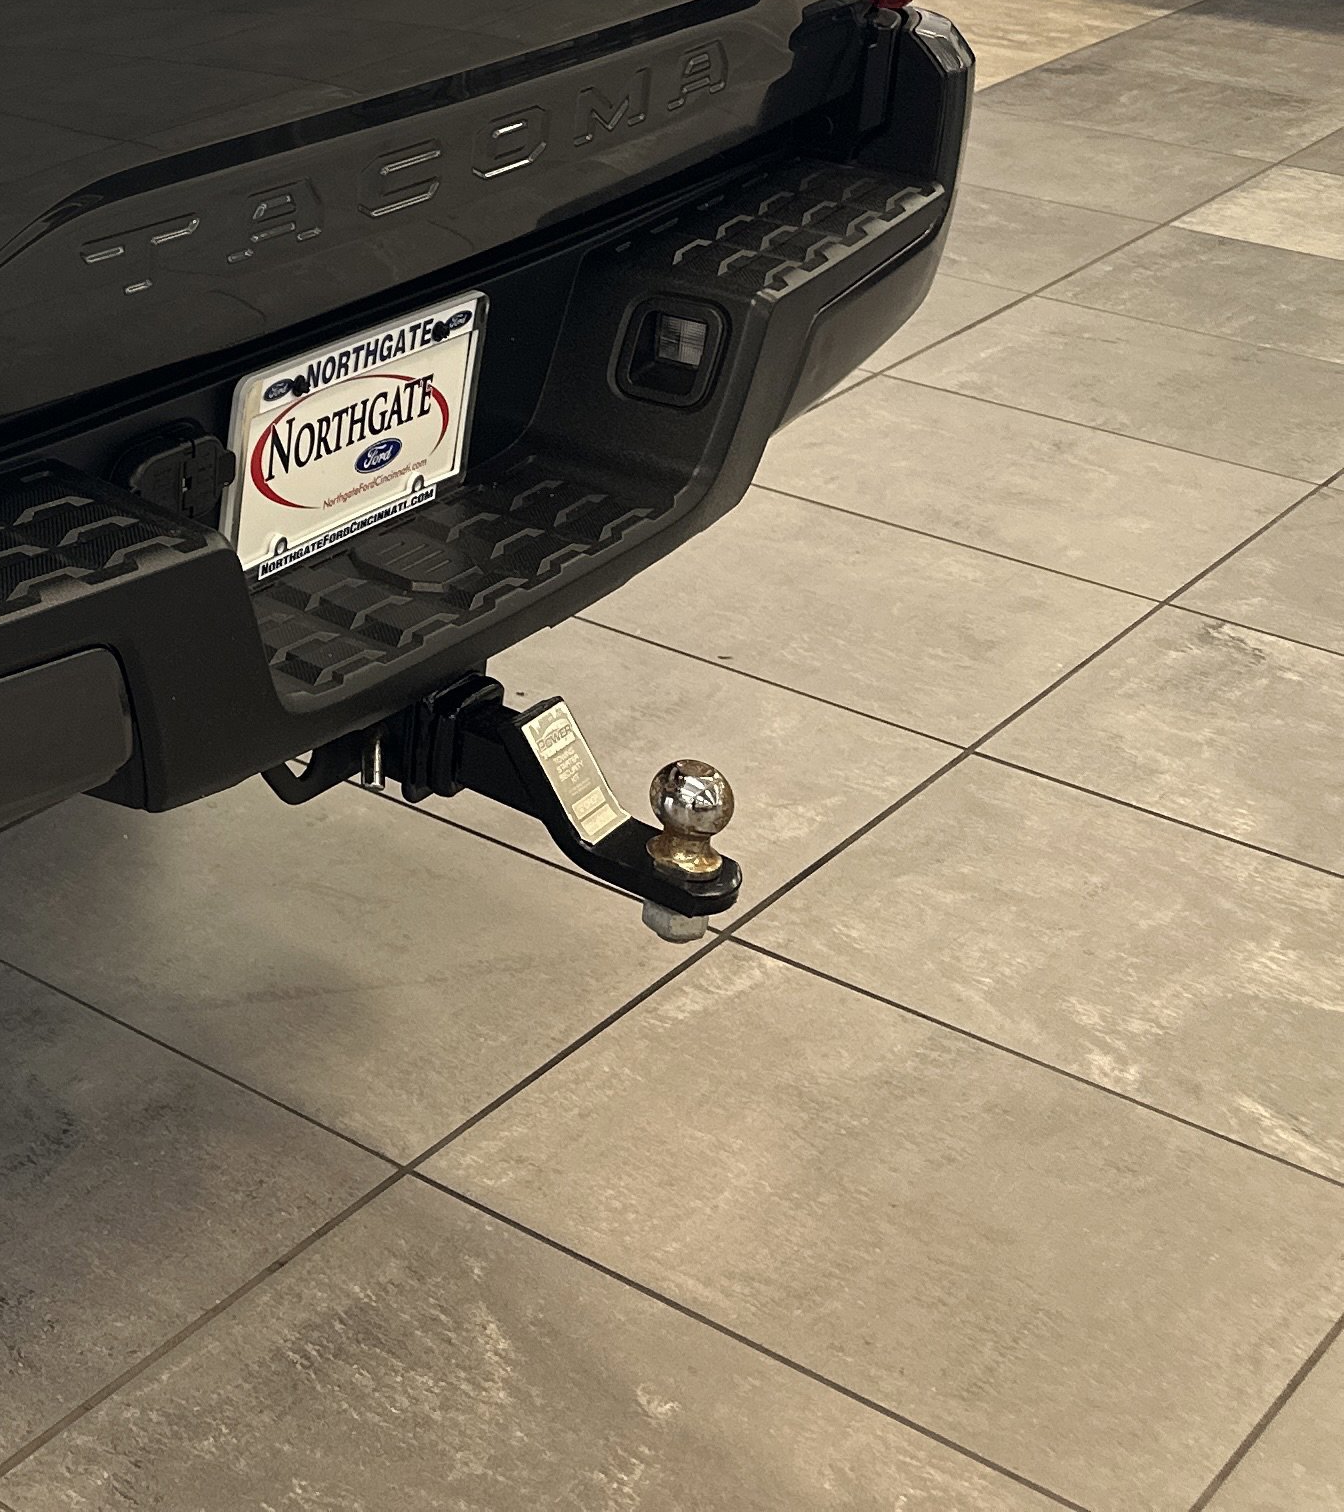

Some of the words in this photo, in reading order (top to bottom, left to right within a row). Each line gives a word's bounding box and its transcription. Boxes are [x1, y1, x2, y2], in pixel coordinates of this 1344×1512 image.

[79, 38, 730, 296] TACOMA
[306, 317, 435, 391] NORTHGATE
[363, 443, 394, 469] Ford
[535, 723, 572, 754] POWER
